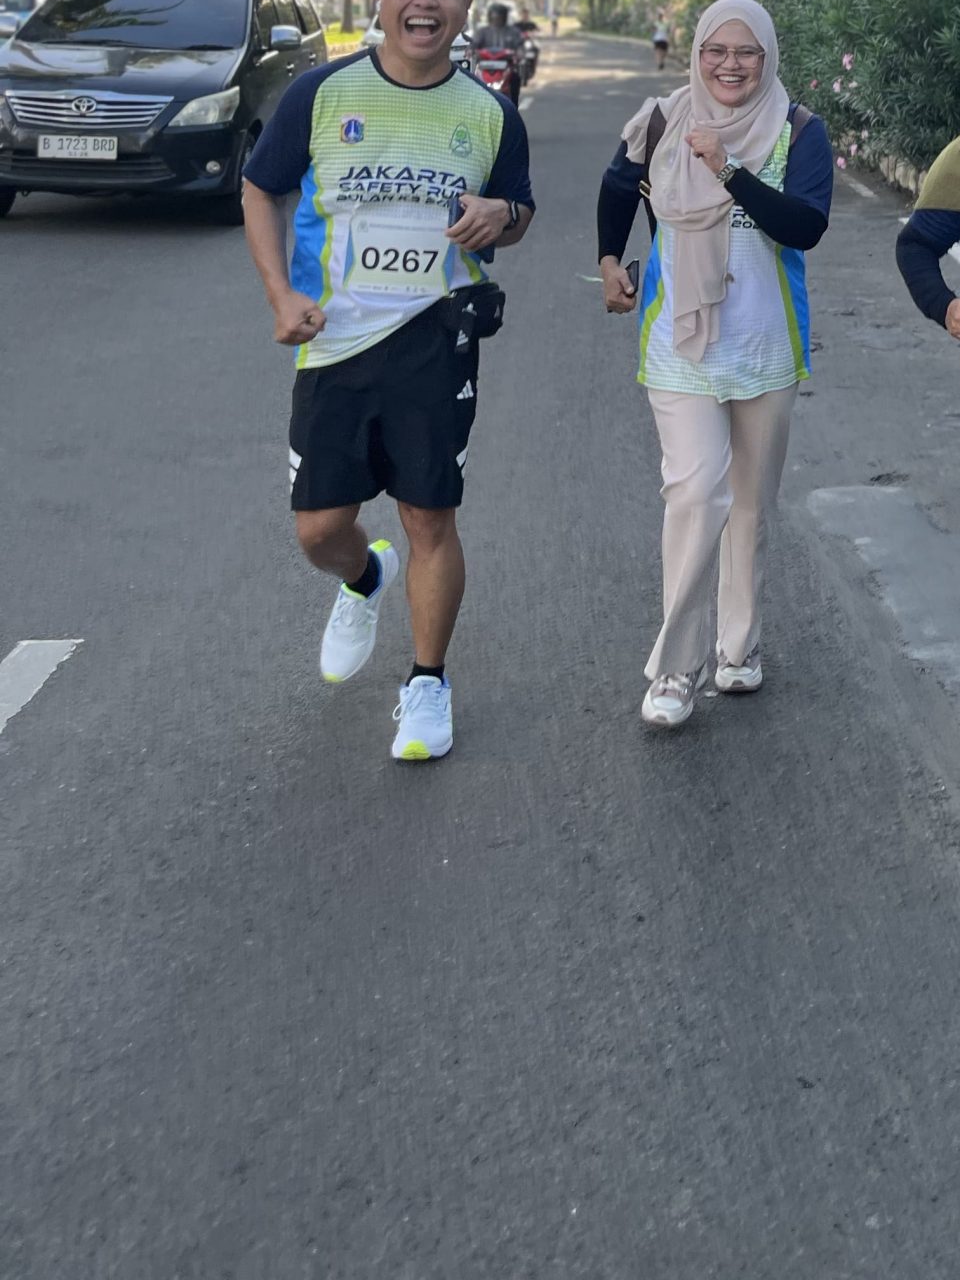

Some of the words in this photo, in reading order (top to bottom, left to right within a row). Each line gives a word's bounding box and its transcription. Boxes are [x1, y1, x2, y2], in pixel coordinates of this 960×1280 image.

[43, 137, 50, 150] B
[57, 138, 88, 151] 1723
[93, 138, 115, 152] BRD
[339, 166, 468, 190] JAKARTA
[339, 181, 422, 194] SAFETY
[361, 247, 439, 273] 0267
